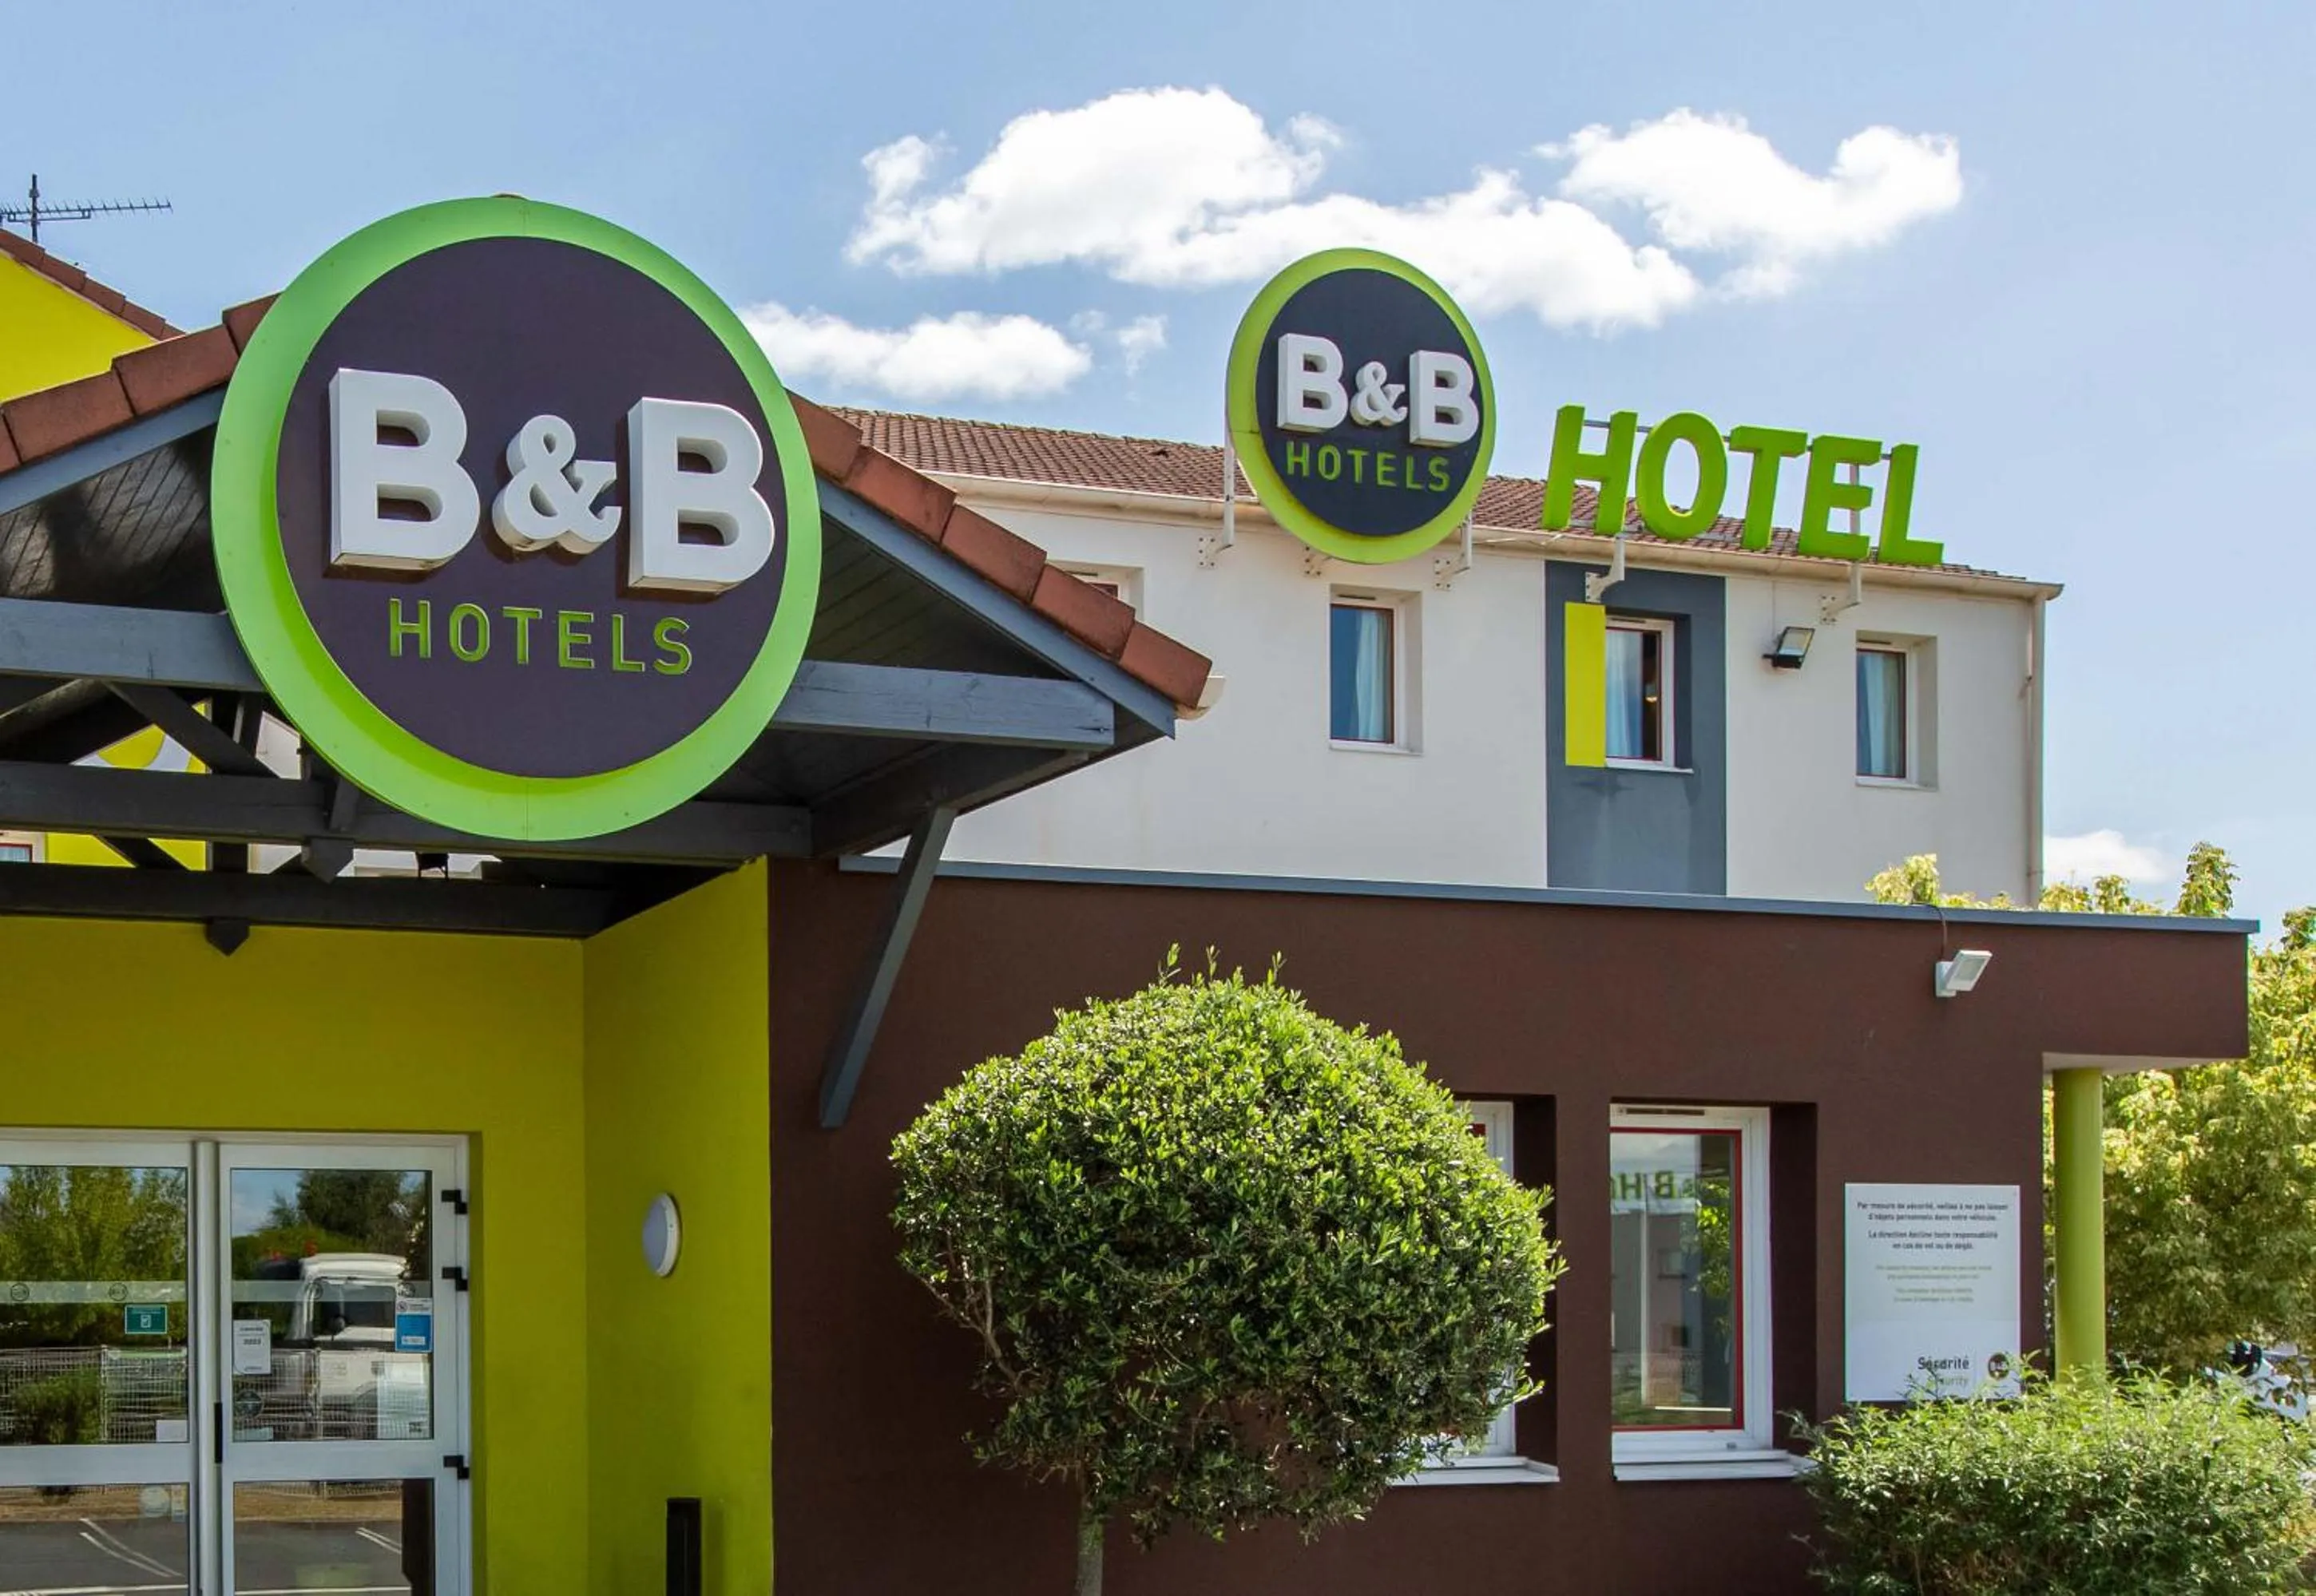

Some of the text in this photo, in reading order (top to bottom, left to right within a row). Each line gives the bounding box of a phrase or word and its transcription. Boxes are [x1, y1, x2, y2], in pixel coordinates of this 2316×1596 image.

[1277, 333, 1479, 448] B&B
[328, 367, 775, 595] B&B
[1285, 440, 1451, 493] HOTELS
[1541, 404, 1945, 568] HOTEL
[388, 597, 693, 676] HOTELS
